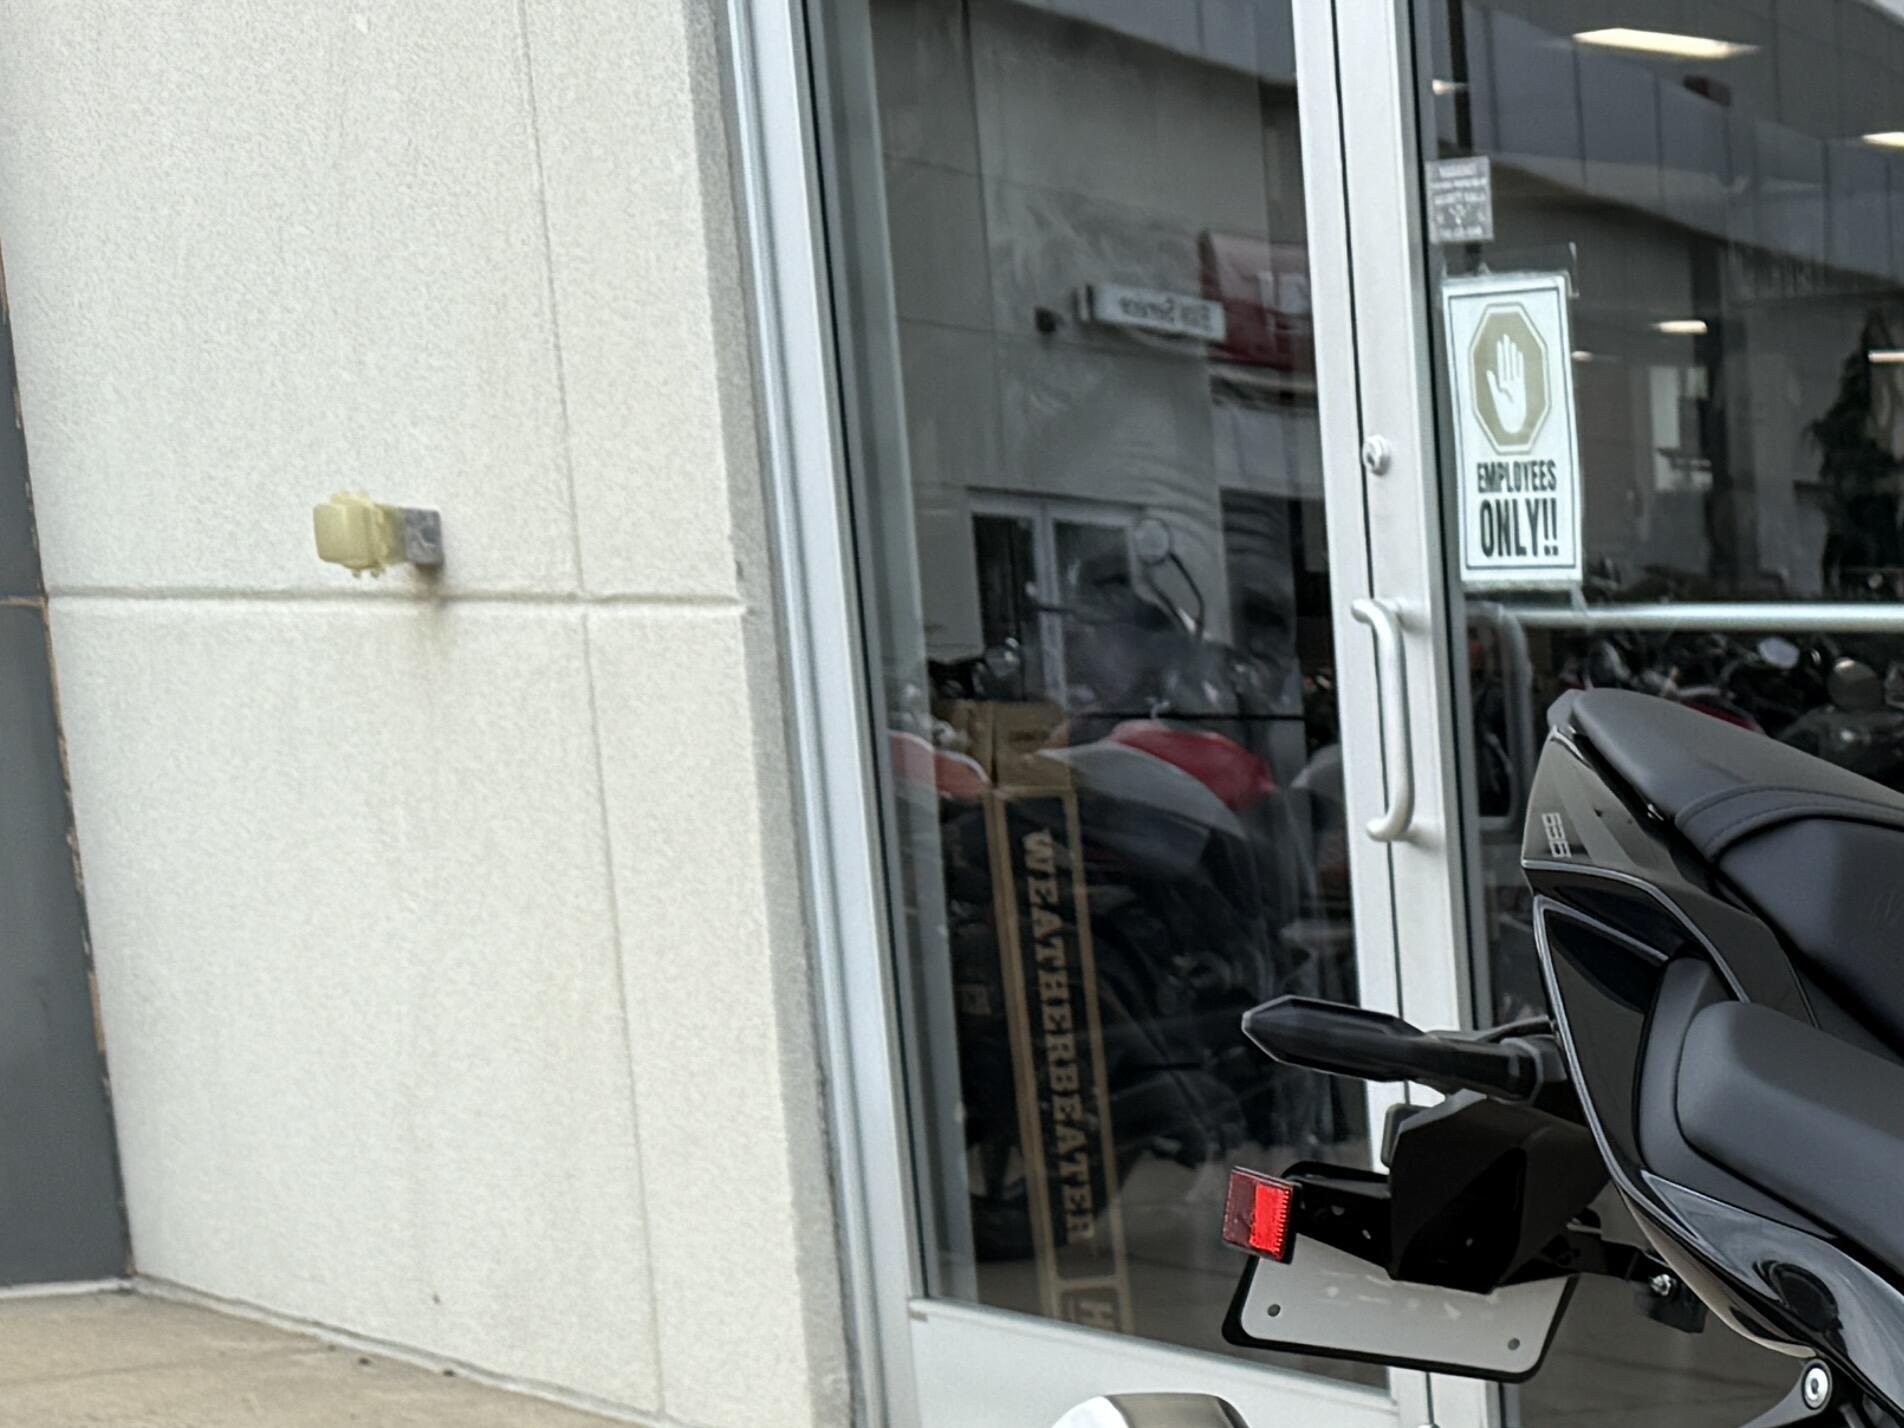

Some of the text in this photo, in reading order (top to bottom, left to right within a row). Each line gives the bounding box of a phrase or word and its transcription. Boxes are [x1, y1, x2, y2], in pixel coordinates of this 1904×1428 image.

[1477, 459, 1557, 493] EMPLOYEES
[1480, 498, 1559, 557] ONLY!!
[1021, 827, 1096, 1245] WEATHERBEATER
